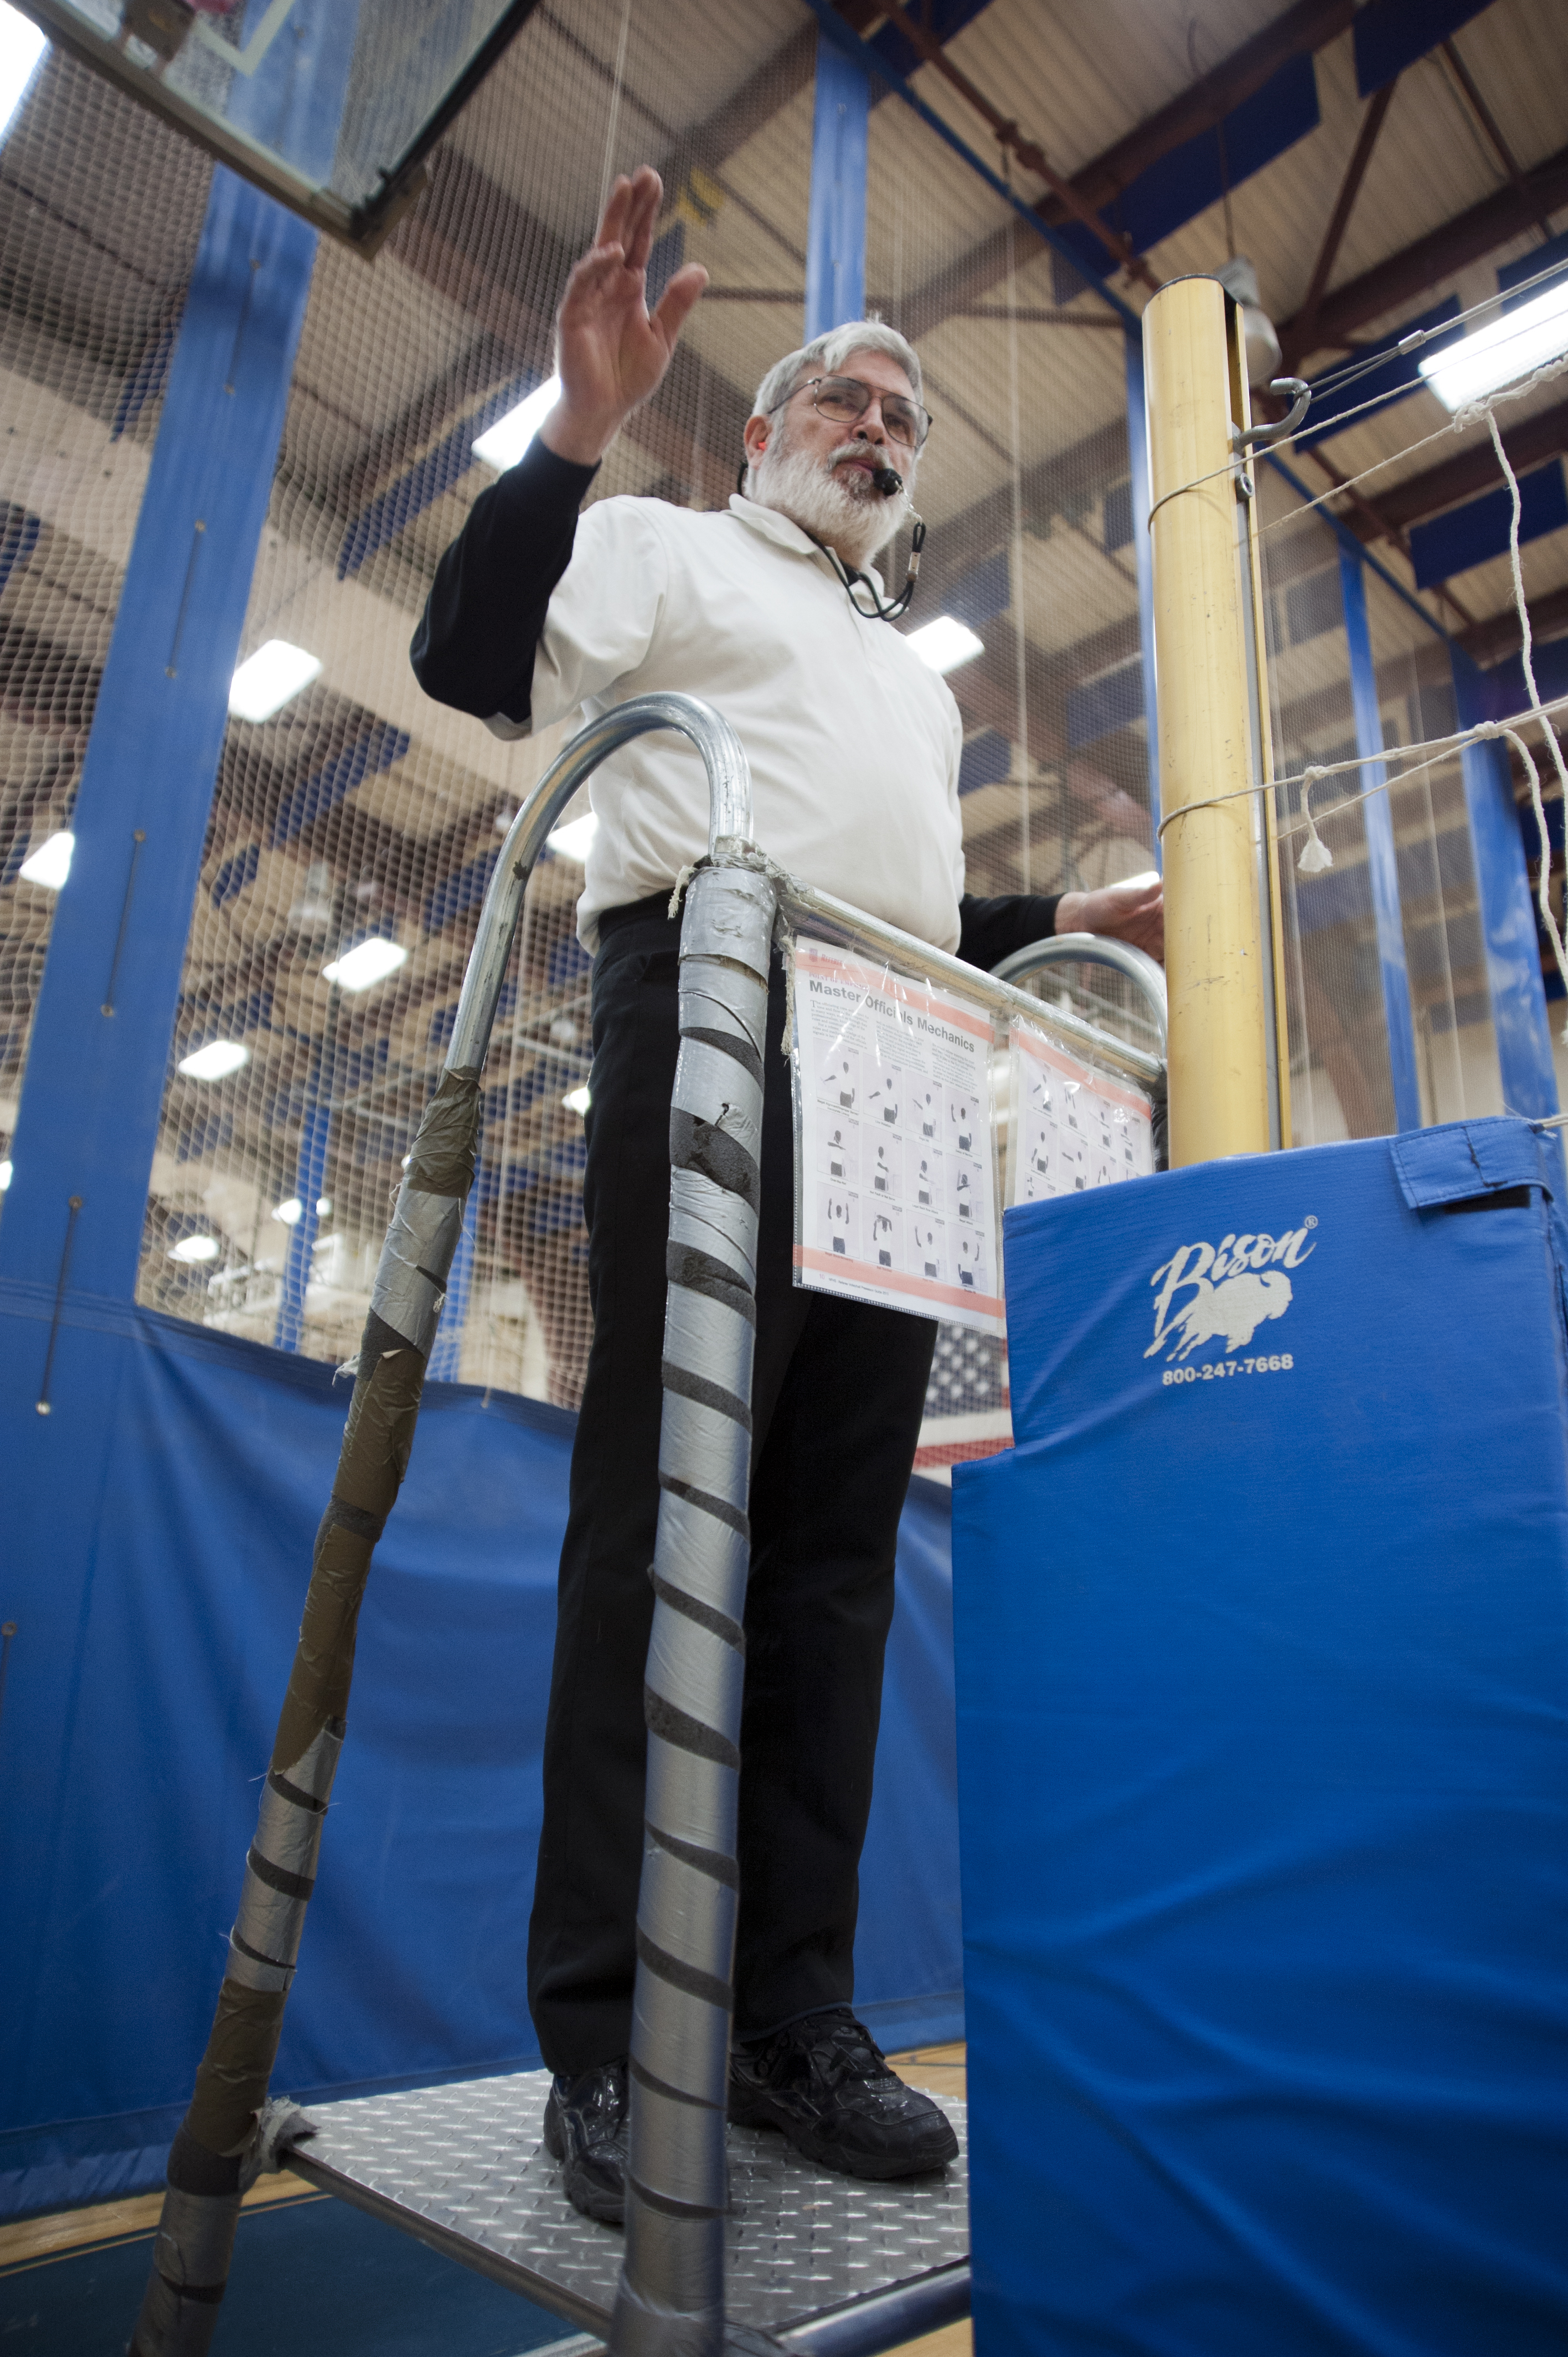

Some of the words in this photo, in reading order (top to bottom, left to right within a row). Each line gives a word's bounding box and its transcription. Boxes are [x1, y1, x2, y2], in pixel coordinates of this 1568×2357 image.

[809, 972, 828, 981] POINT
[809, 980, 861, 1003] Master
[917, 1016, 975, 1053] Mechanics
[1144, 1228, 1317, 1358] Bison
[1163, 1354, 1293, 1385] 800-247-7668
